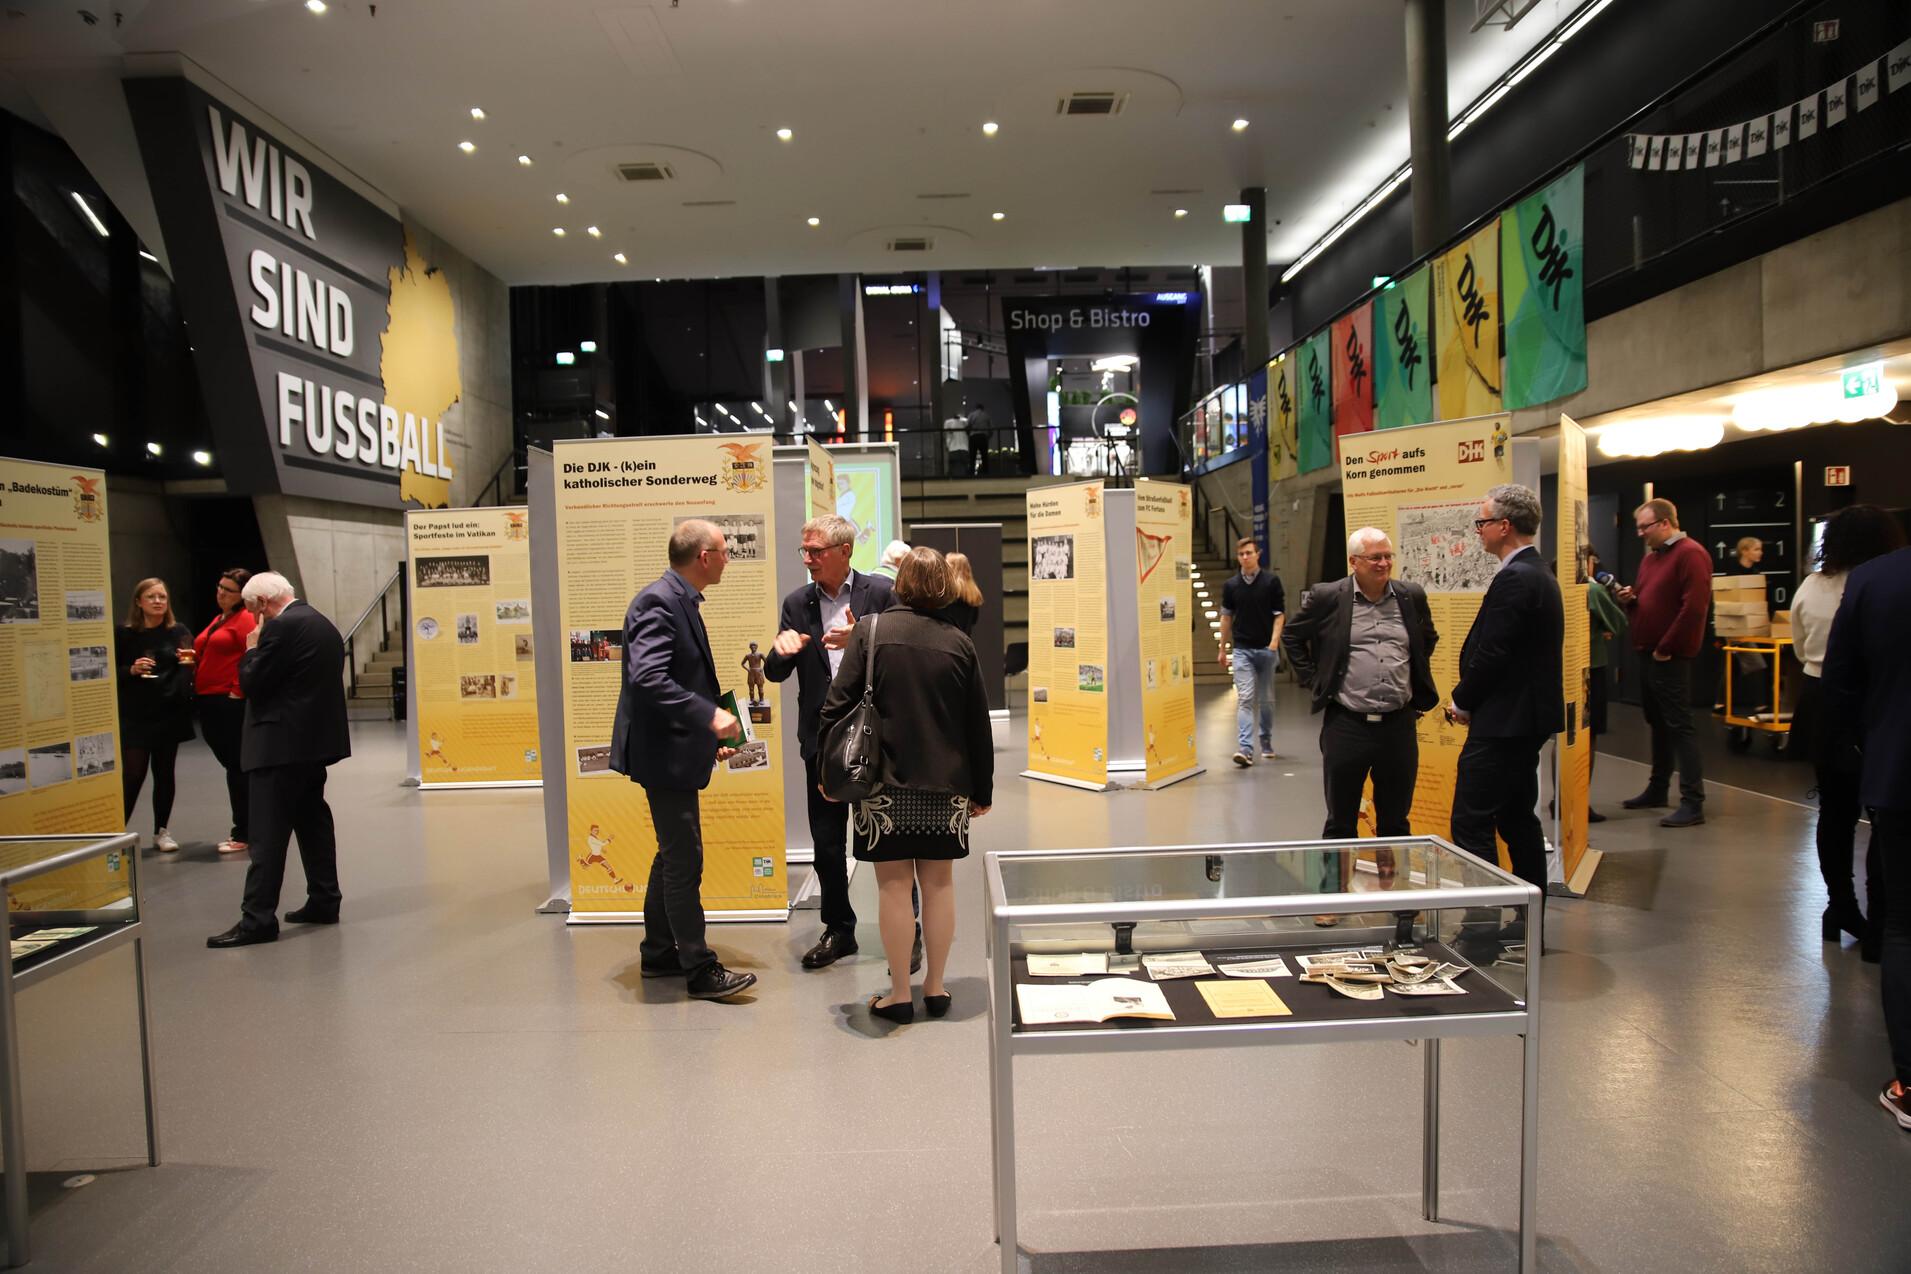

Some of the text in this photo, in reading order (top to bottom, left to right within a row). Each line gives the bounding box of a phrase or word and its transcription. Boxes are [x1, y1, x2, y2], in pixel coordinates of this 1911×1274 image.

[208, 105, 316, 240] WIR
[250, 249, 353, 357] SIND
[1011, 308, 1151, 334] Shop & Bistro
[278, 371, 453, 481] FUSSBALL
[1345, 456, 1364, 465] Den
[1402, 447, 1426, 459] aufs
[563, 463, 584, 473] Die
[587, 462, 611, 473] DJK
[620, 460, 656, 473] (k)ein
[1346, 464, 1426, 480] Korn genommen
[564, 473, 718, 490] katholischer Sonderweg
[1775, 491, 1785, 507] 2
[413, 523, 427, 531] Der
[428, 522, 450, 531] Papst
[413, 531, 454, 540] Sportfeste
[467, 530, 496, 538] Vatikan
[1776, 540, 1784, 556] 1
[1775, 587, 1786, 603] 0
